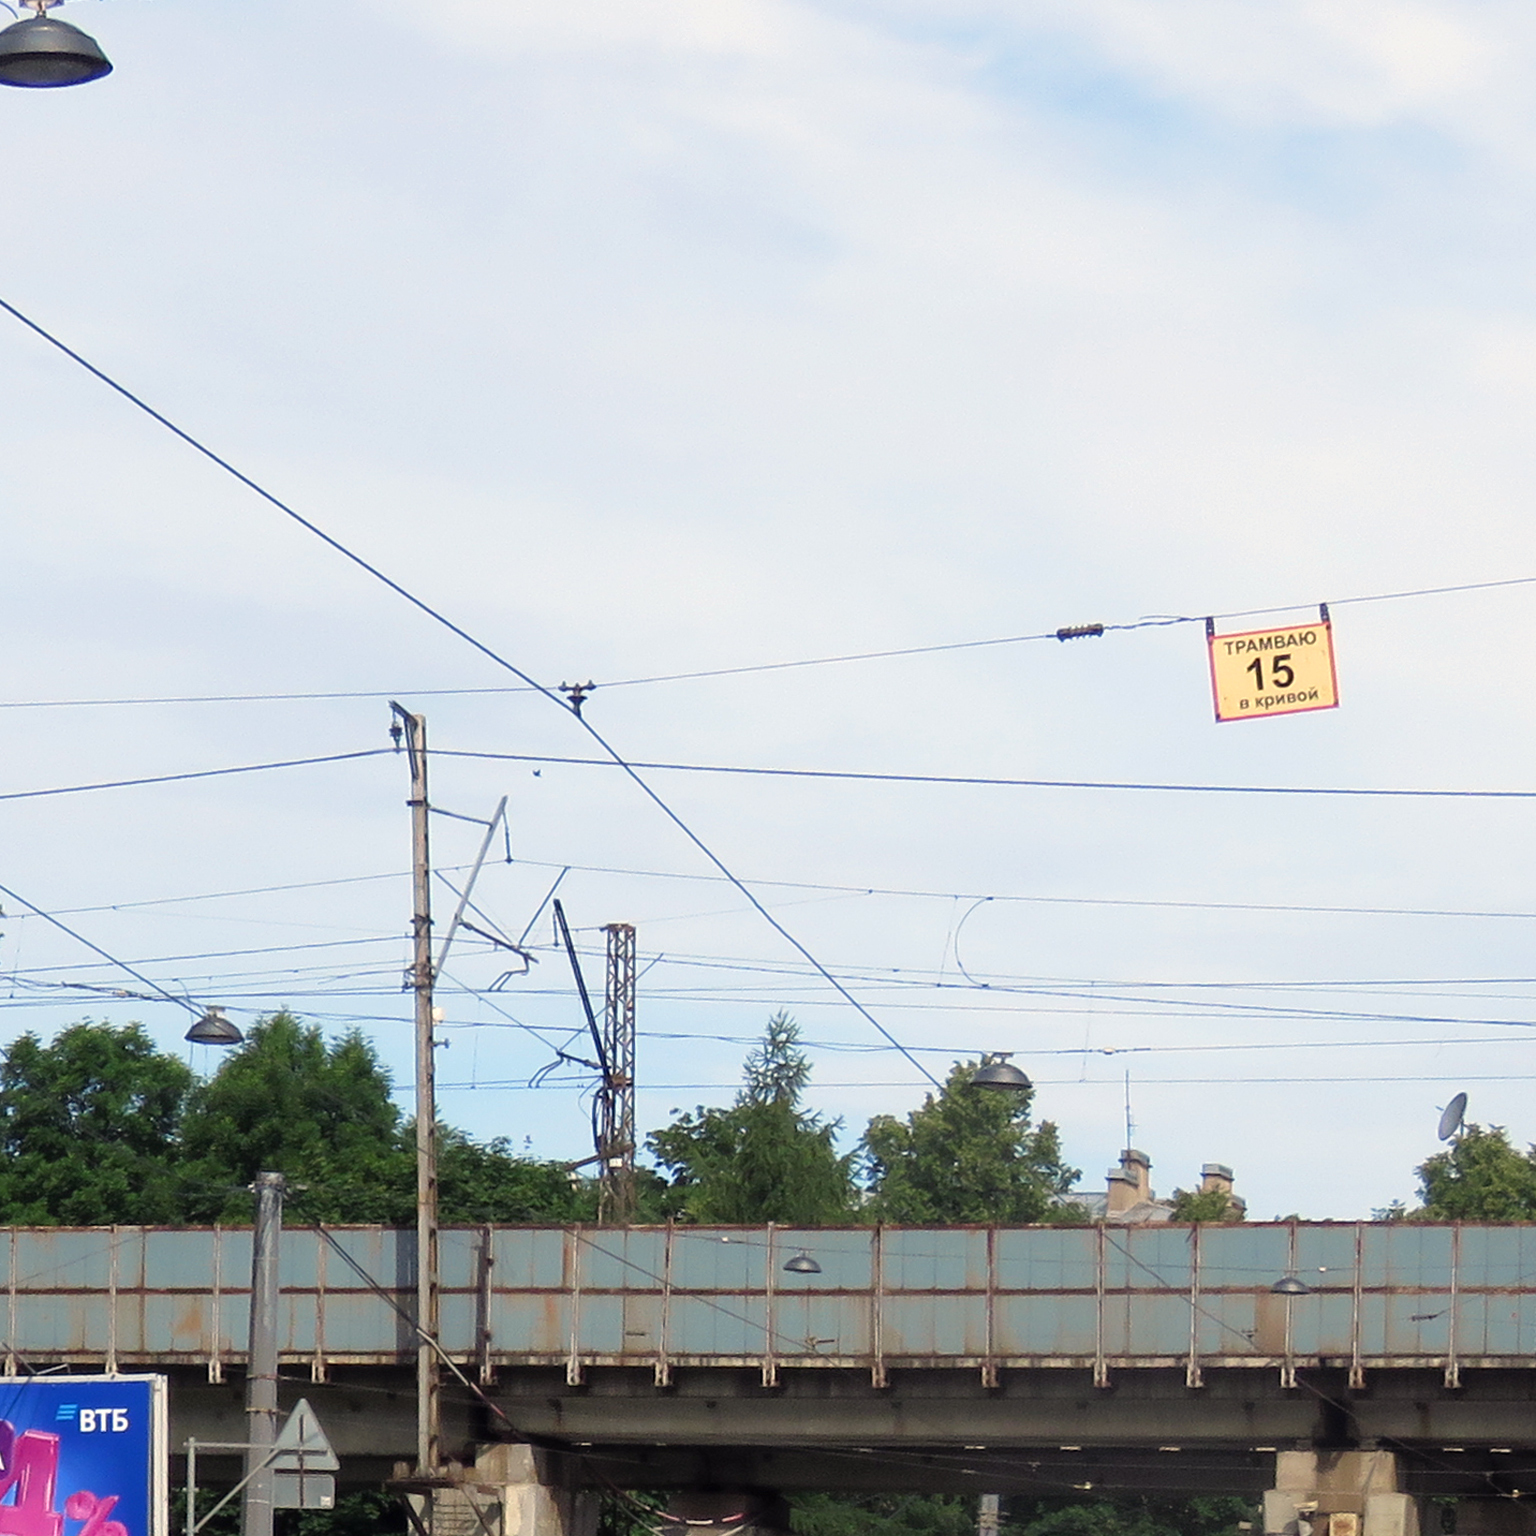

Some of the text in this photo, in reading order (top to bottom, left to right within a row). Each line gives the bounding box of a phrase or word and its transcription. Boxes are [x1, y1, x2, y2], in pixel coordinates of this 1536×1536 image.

[1224, 630, 1317, 655] ТРАМВАЮ
[1246, 654, 1294, 692] 15
[1239, 686, 1320, 710] в кривой
[79, 1408, 129, 1433] ВТБ
